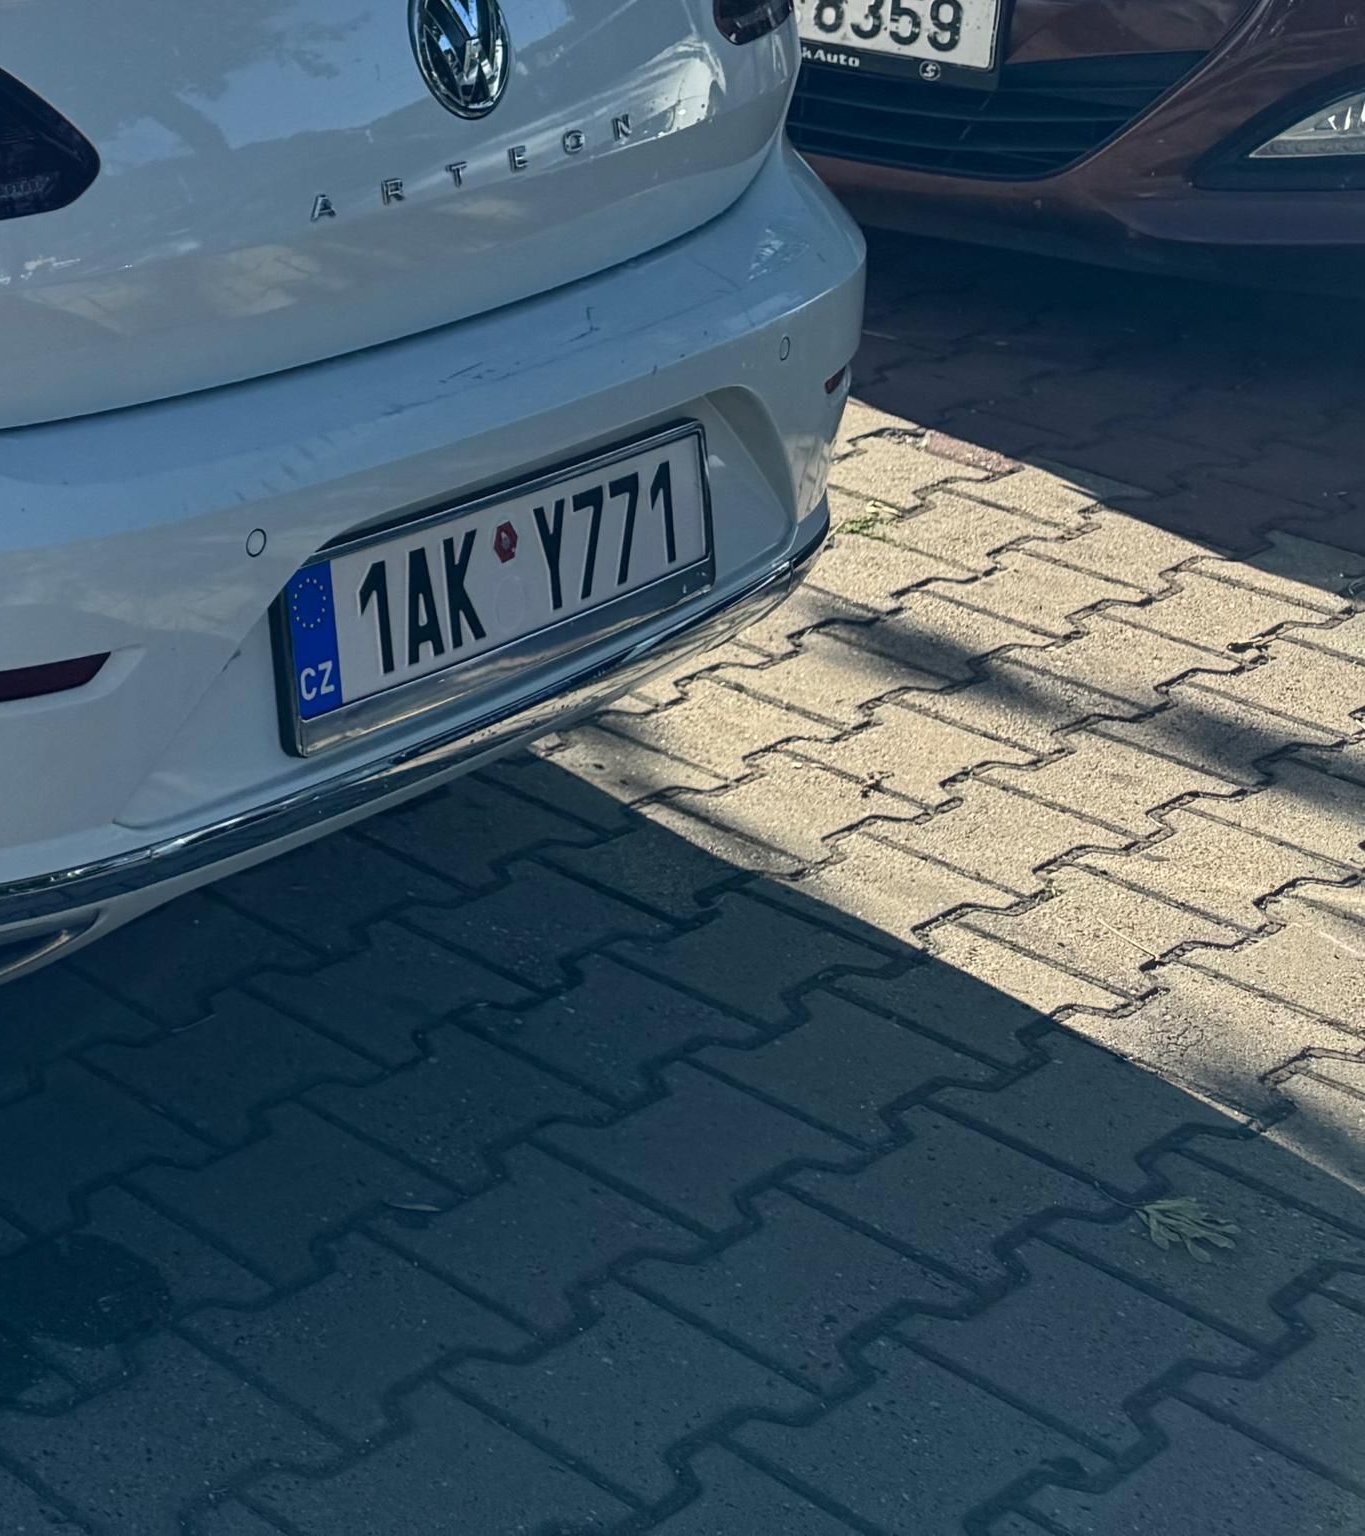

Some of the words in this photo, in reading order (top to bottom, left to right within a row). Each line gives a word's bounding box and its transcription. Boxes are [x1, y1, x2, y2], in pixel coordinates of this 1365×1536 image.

[310, 113, 633, 222] ARTEON
[359, 528, 487, 675] 1AK
[533, 461, 677, 611] Y771
[300, 660, 336, 702] CZ
